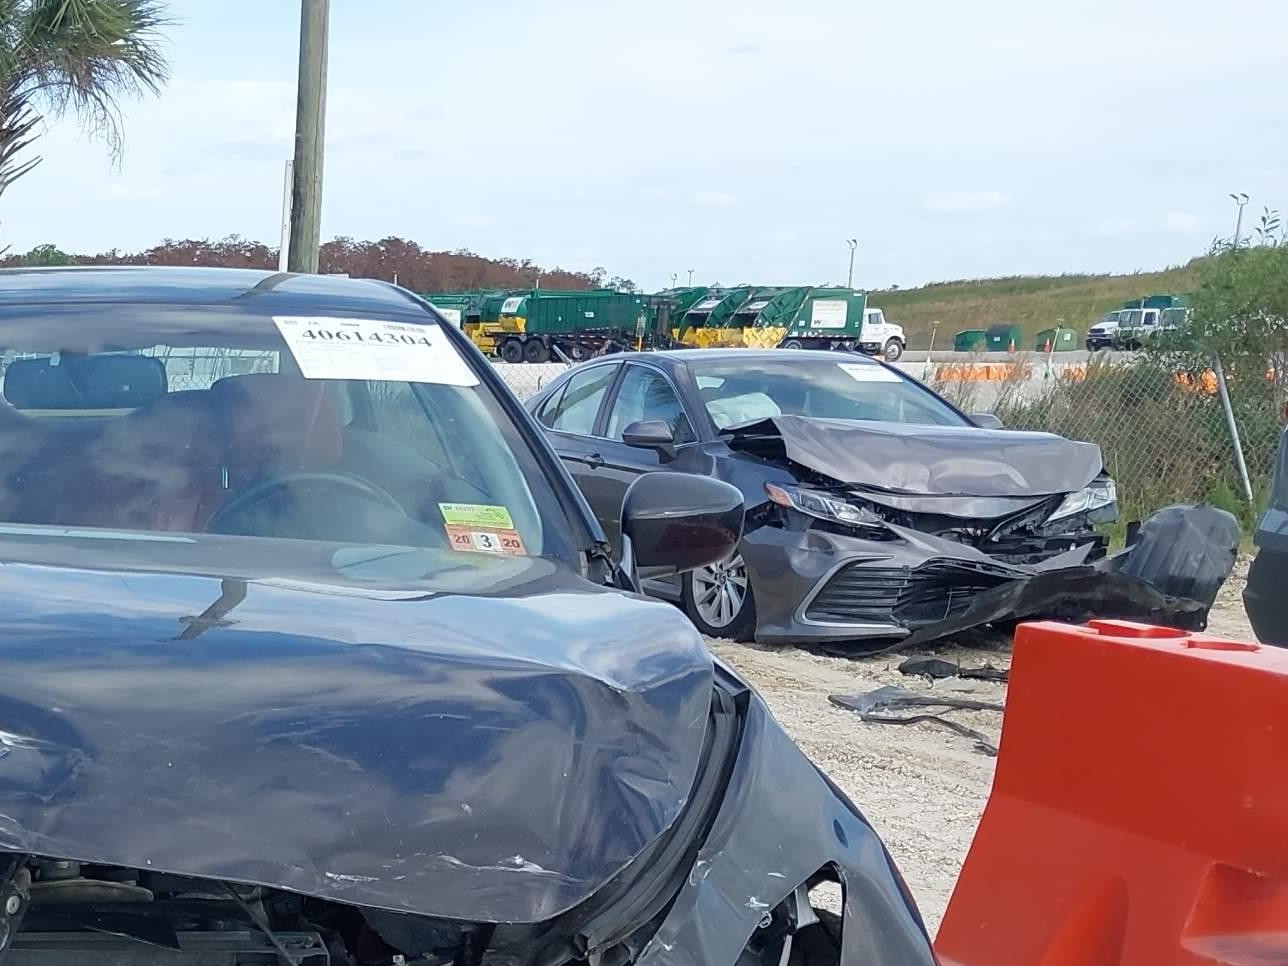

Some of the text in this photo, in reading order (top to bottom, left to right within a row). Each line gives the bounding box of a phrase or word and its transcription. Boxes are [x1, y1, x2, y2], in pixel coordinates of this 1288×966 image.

[301, 329, 433, 348] 40614304
[454, 534, 521, 549] 20 3 20
